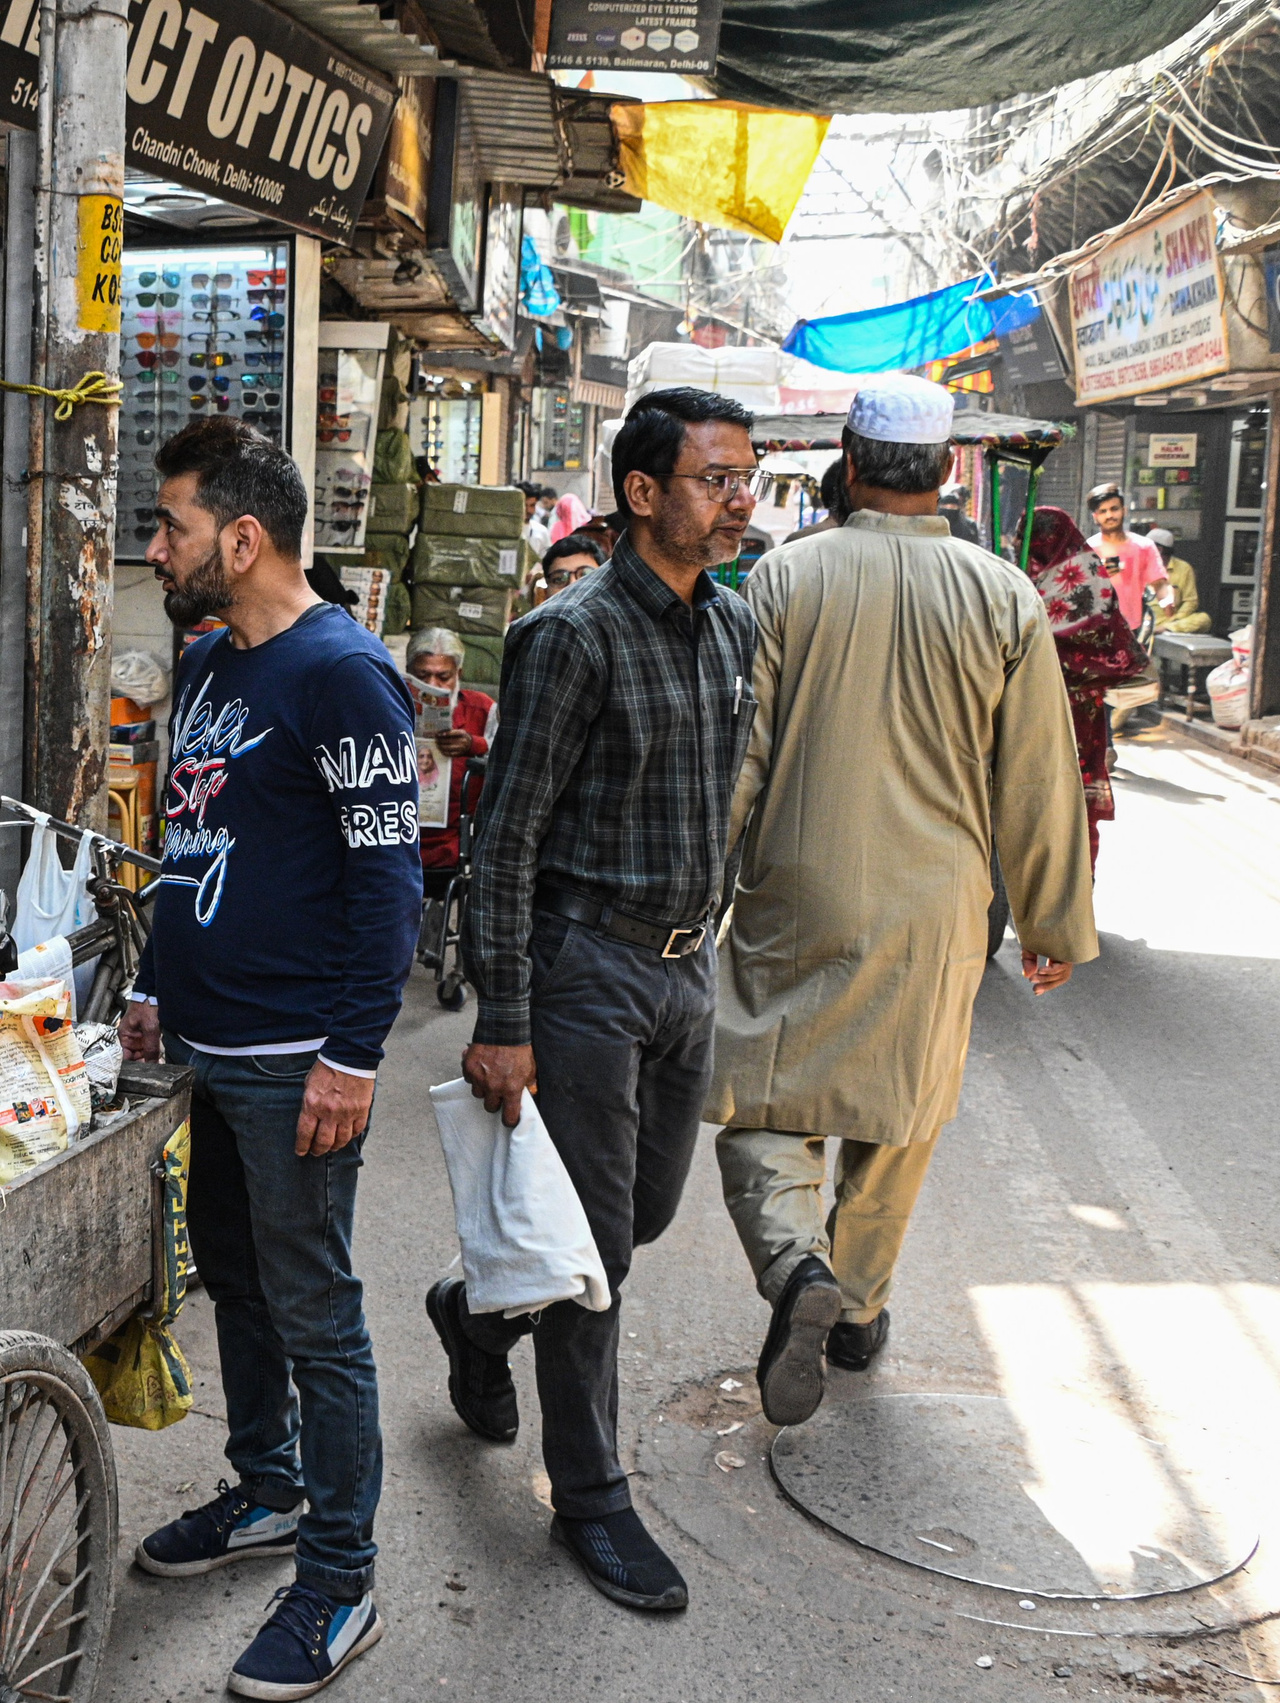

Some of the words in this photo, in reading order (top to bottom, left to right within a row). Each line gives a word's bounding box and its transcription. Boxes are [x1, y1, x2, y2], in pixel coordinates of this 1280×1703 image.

[588, 3, 646, 14] COMPUTERIZED
[648, 5, 665, 14] EYE
[666, 5, 698, 15] TESTING
[635, 17, 664, 27] LATEST
[665, 18, 696, 28] FRAMES
[207, 36, 373, 191] OPTICS
[132, 126, 183, 168] Chandni
[182, 148, 221, 187] Chowk,
[222, 164, 285, 205] Delhi-110006
